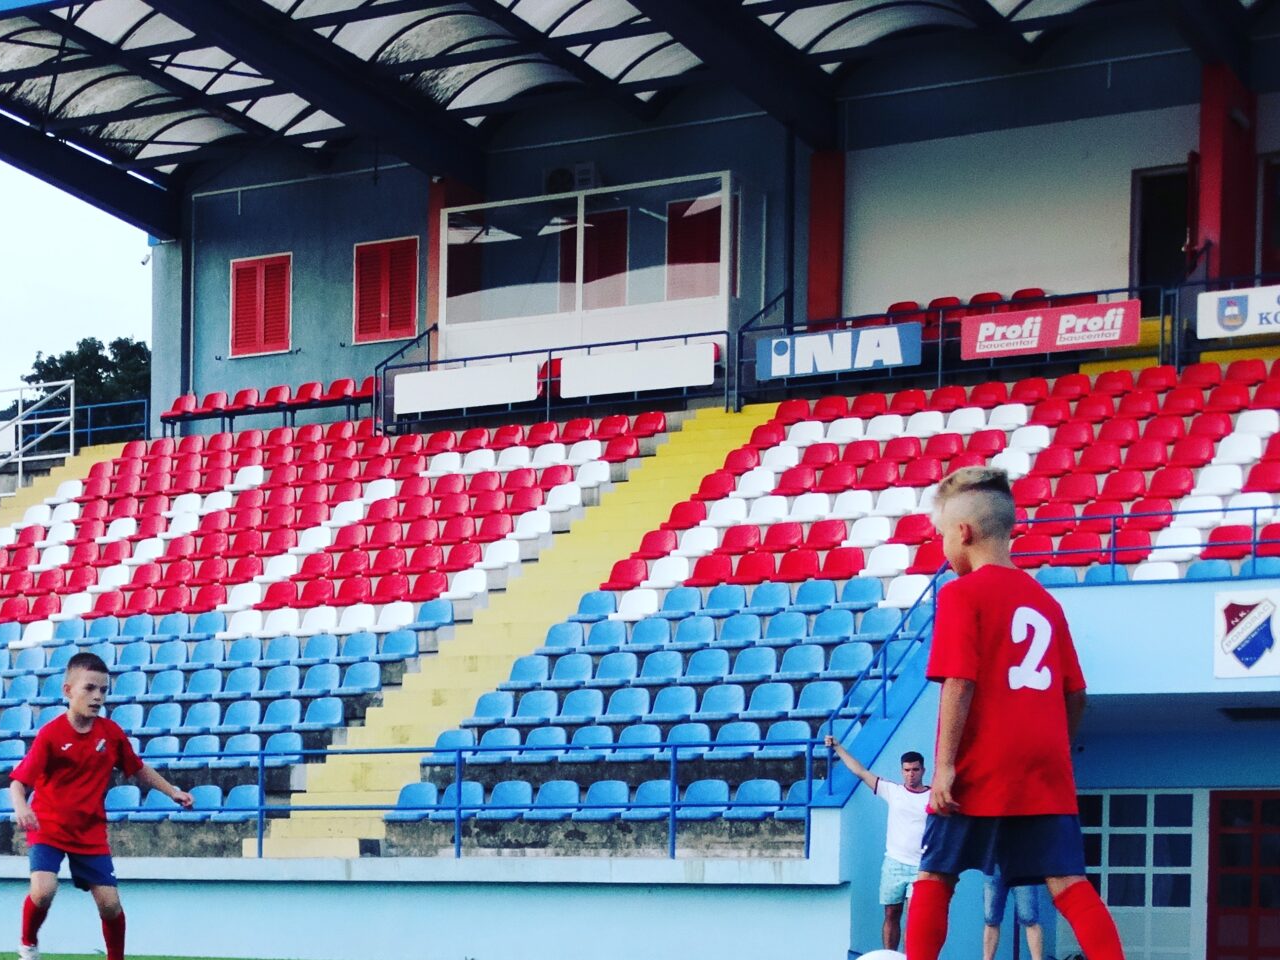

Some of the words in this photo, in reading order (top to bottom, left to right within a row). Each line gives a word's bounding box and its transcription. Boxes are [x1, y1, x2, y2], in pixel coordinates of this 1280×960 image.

[979, 316, 1043, 342] Profi
[1058, 307, 1125, 333] Profi
[1008, 606, 1052, 691] 2
